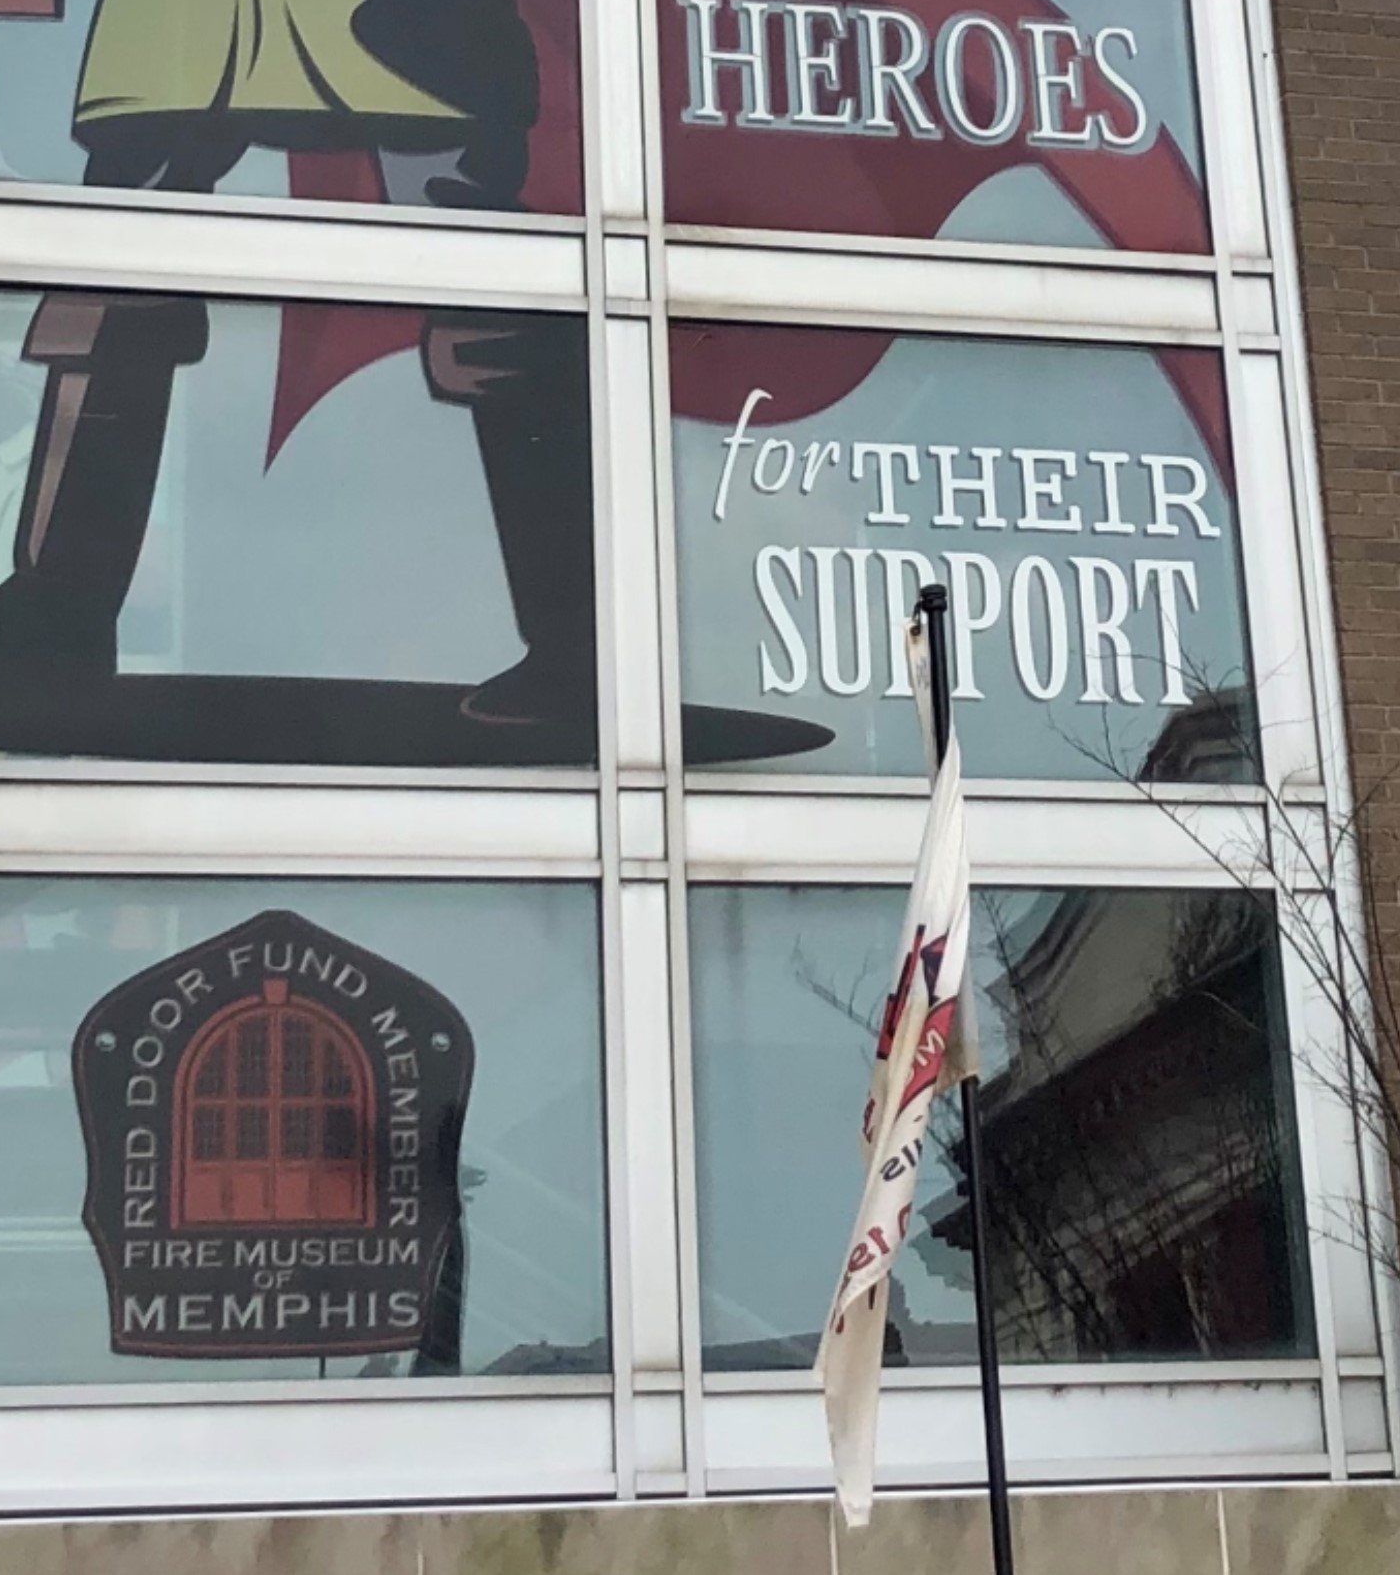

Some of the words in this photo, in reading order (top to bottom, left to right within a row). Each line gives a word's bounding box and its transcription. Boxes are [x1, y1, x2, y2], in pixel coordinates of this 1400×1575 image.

[713, 388, 840, 520] for
[852, 441, 1221, 537] THEIR
[755, 545, 1200, 705] SUPPORT
[228, 942, 369, 1000] FUND
[127, 968, 215, 1107] DOOR
[371, 1006, 420, 1226] MEMBER
[123, 1128, 158, 1228] RED
[124, 1239, 223, 1269] FIRE
[233, 1238, 420, 1267] MUSEUM
[253, 1270, 295, 1289] OF
[123, 1293, 421, 1332] MEMPHIS
